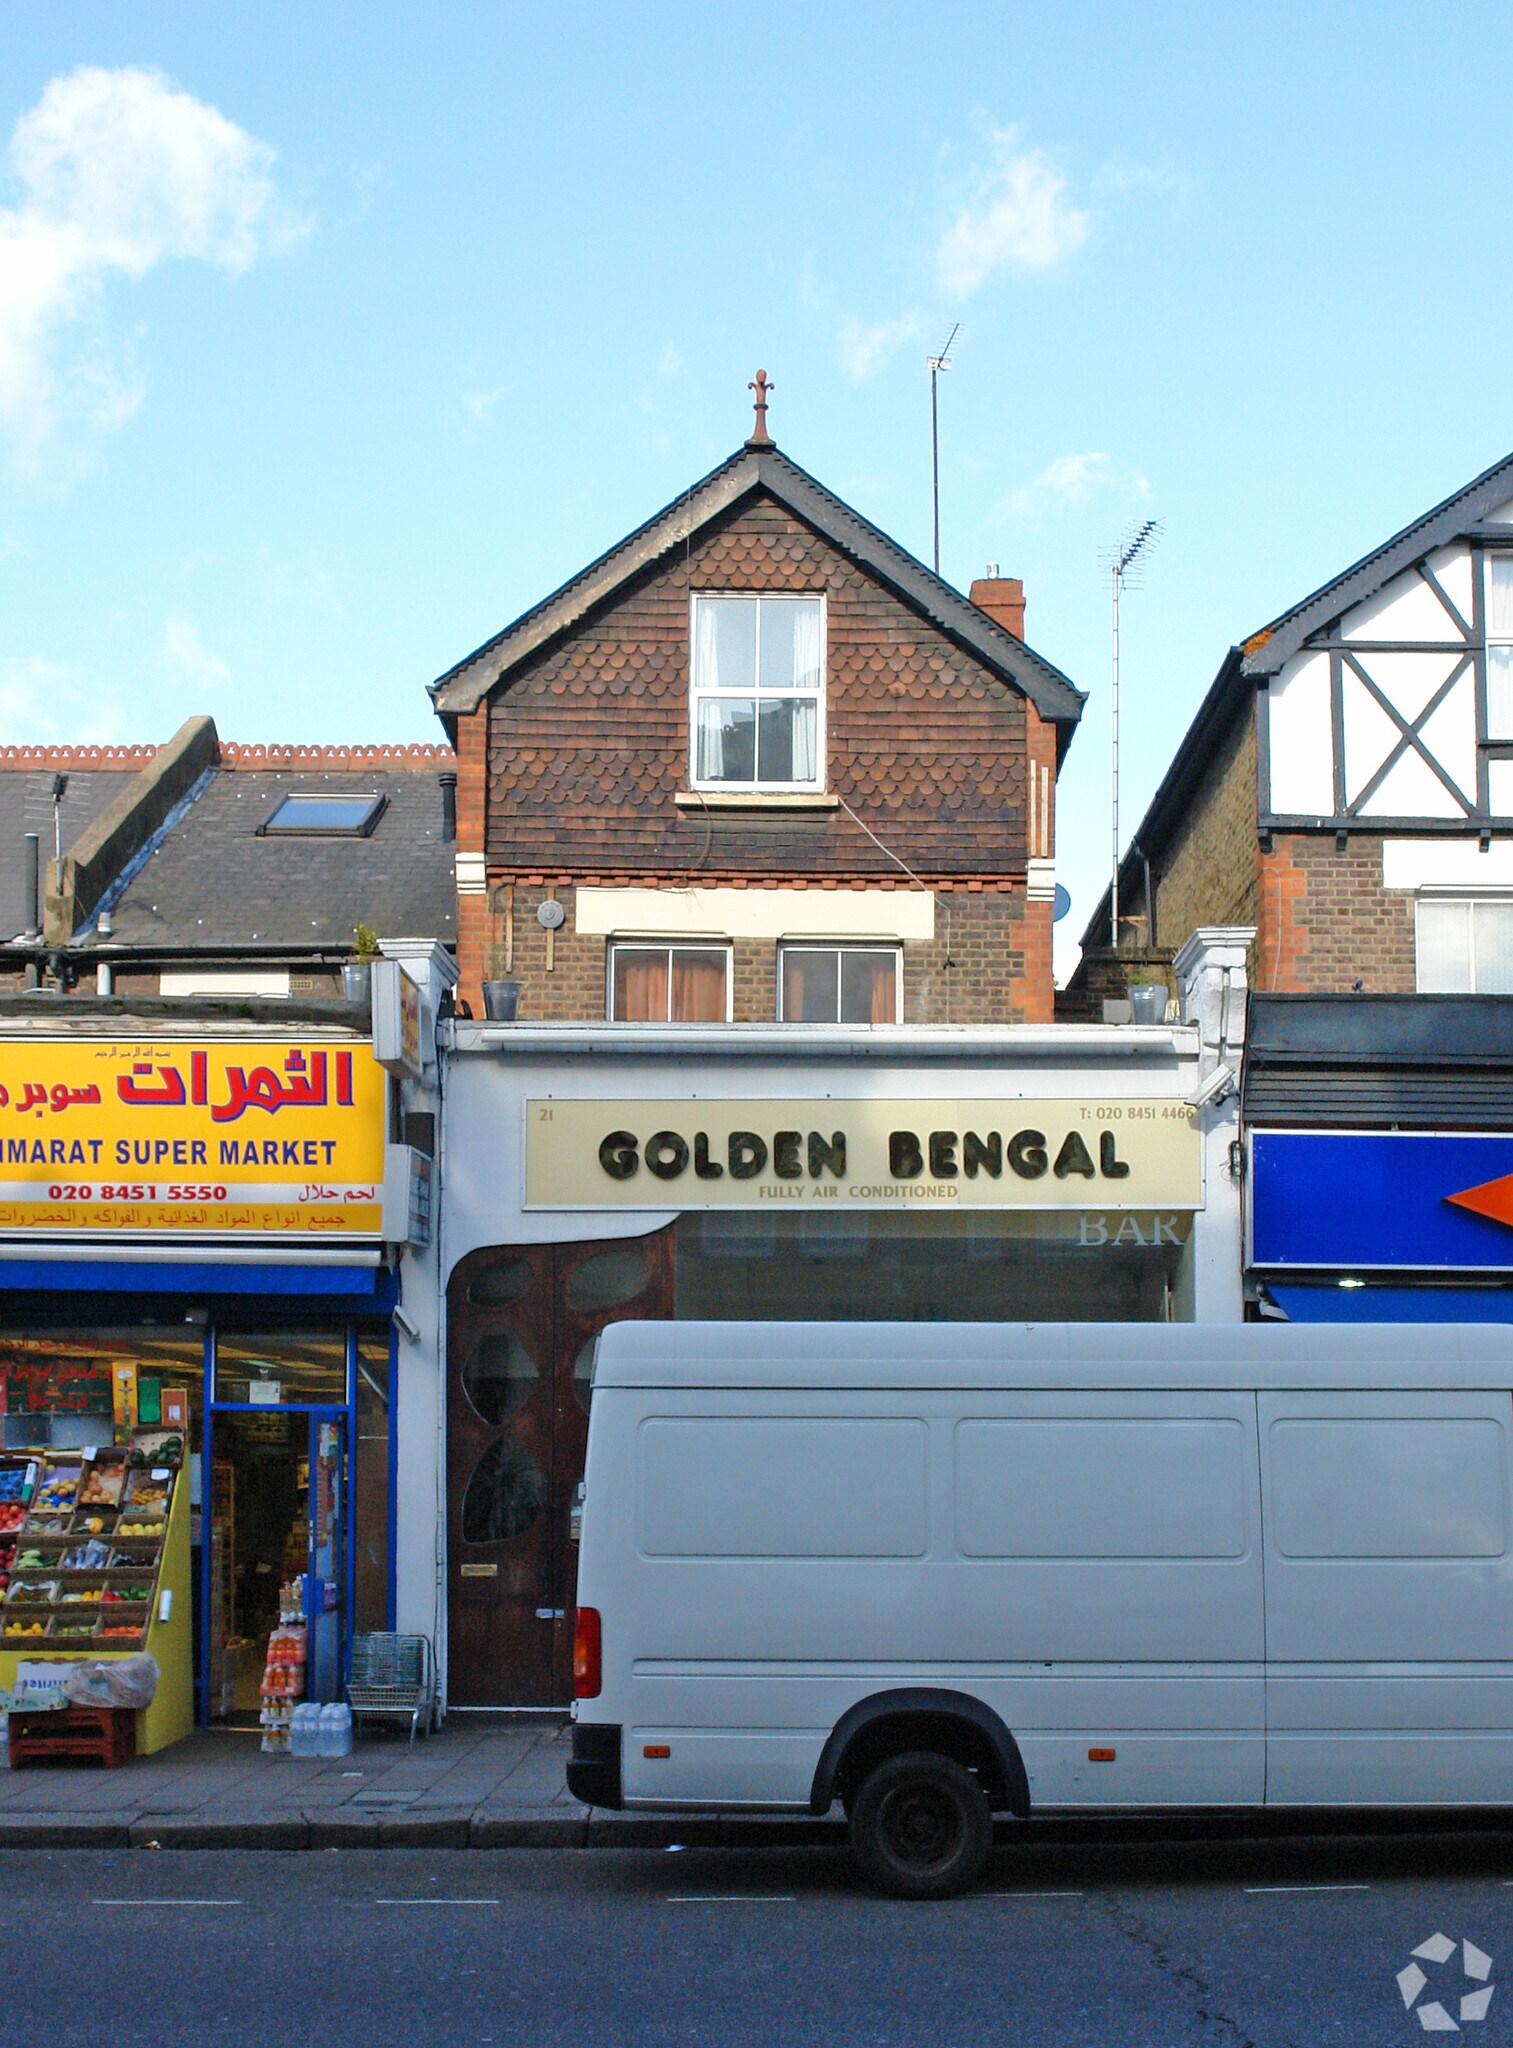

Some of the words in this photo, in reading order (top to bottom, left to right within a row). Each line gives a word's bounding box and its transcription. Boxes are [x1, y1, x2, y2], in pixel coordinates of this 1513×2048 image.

[117, 1049, 354, 1123] الثمرات
[16, 1083, 101, 1118] سوبر
[539, 1108, 554, 1121] 21
[1080, 1107, 1091, 1120] T:
[1096, 1107, 1122, 1120] 020
[1128, 1107, 1156, 1120] 8451
[115, 1139, 208, 1166] SUPER
[219, 1140, 337, 1166] MARKET
[598, 1130, 847, 1180] GOLDEN
[889, 1129, 1131, 1180] BENGAL
[48, 1184, 92, 1200] 020
[100, 1185, 157, 1200] 8451
[168, 1185, 227, 1201] 5550
[298, 1183, 339, 1202] حلال
[343, 1185, 375, 1203] لحم
[759, 1186, 805, 1199] FULLY
[812, 1186, 839, 1198] AIR
[849, 1185, 958, 1198] CONDITIONED
[216, 1209, 255, 1229] المواد
[307, 1214, 346, 1231] جميع
[1076, 1211, 1185, 1246] BAR
